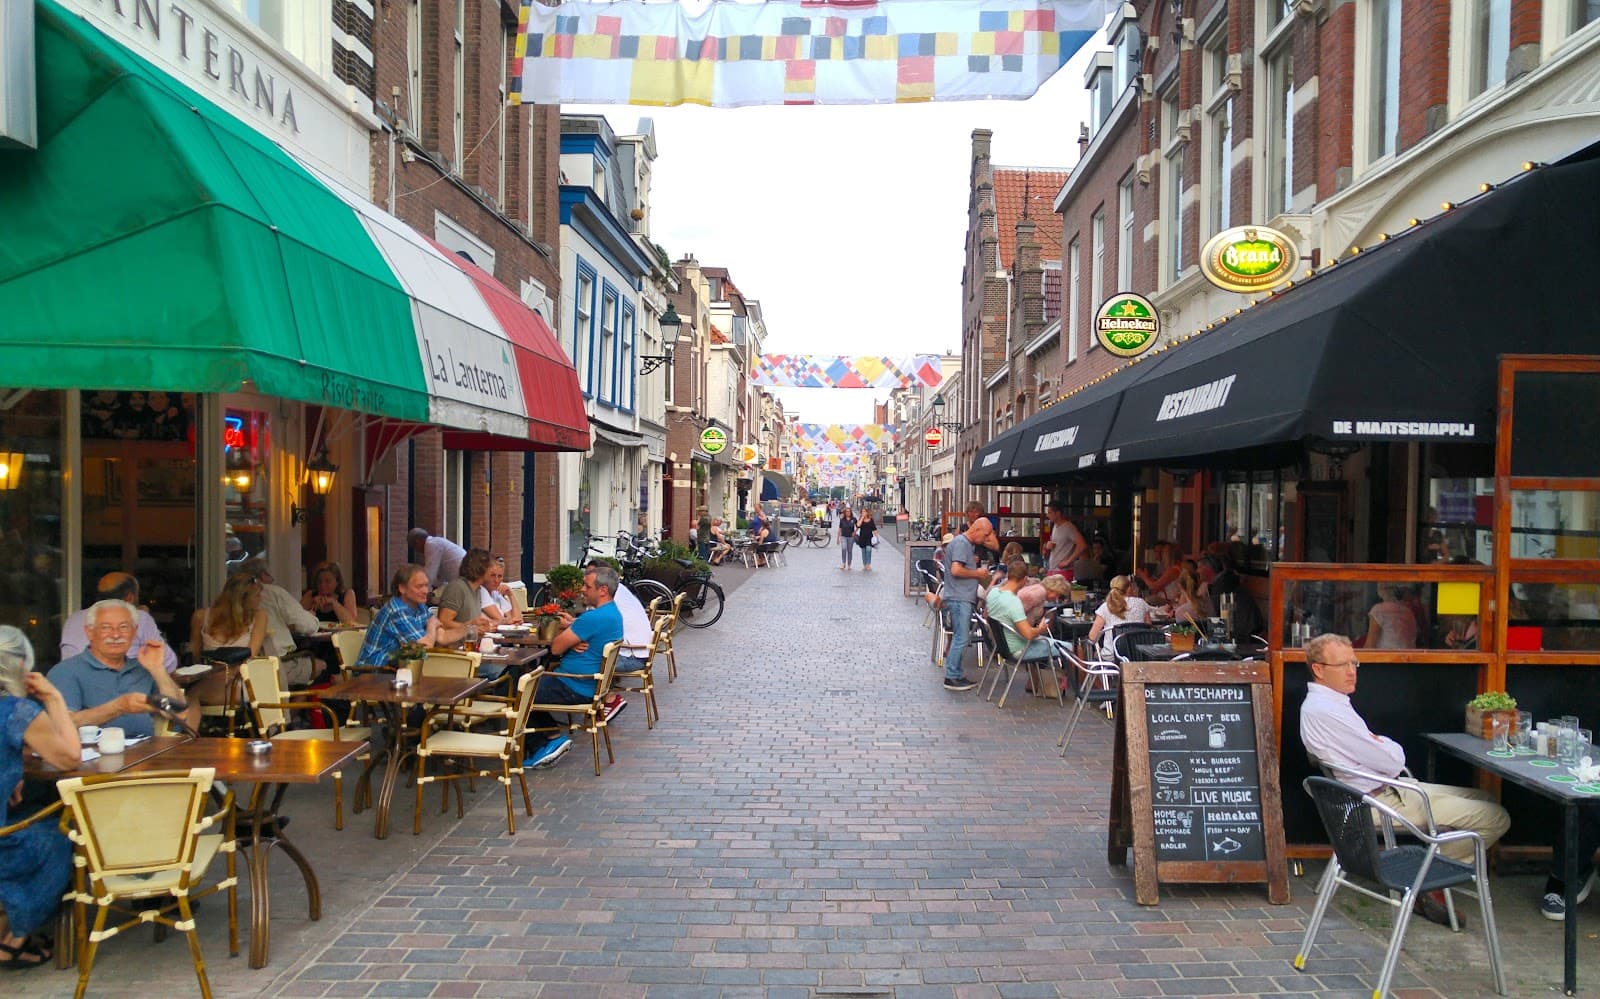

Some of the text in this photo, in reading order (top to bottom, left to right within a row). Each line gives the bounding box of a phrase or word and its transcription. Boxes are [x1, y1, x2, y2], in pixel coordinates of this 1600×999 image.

[111, 0, 302, 134] NTERNA
[1226, 245, 1280, 267] Brand
[1101, 318, 1155, 330] Heineken
[426, 339, 508, 400] La Lanterna
[1156, 374, 1237, 421] RESTAURANT
[1333, 421, 1475, 436] DE MAATSCHAPPIJ
[1145, 687, 1244, 700] DE MAATSCHAPPIJ
[1152, 713, 1241, 723] LOCAL CRAFT BEER
[1211, 757, 1241, 765] BURGERS
[1194, 790, 1252, 803] LIVE MUSIC
[1154, 810, 1177, 819] HOME
[1207, 810, 1258, 821] Heineken
